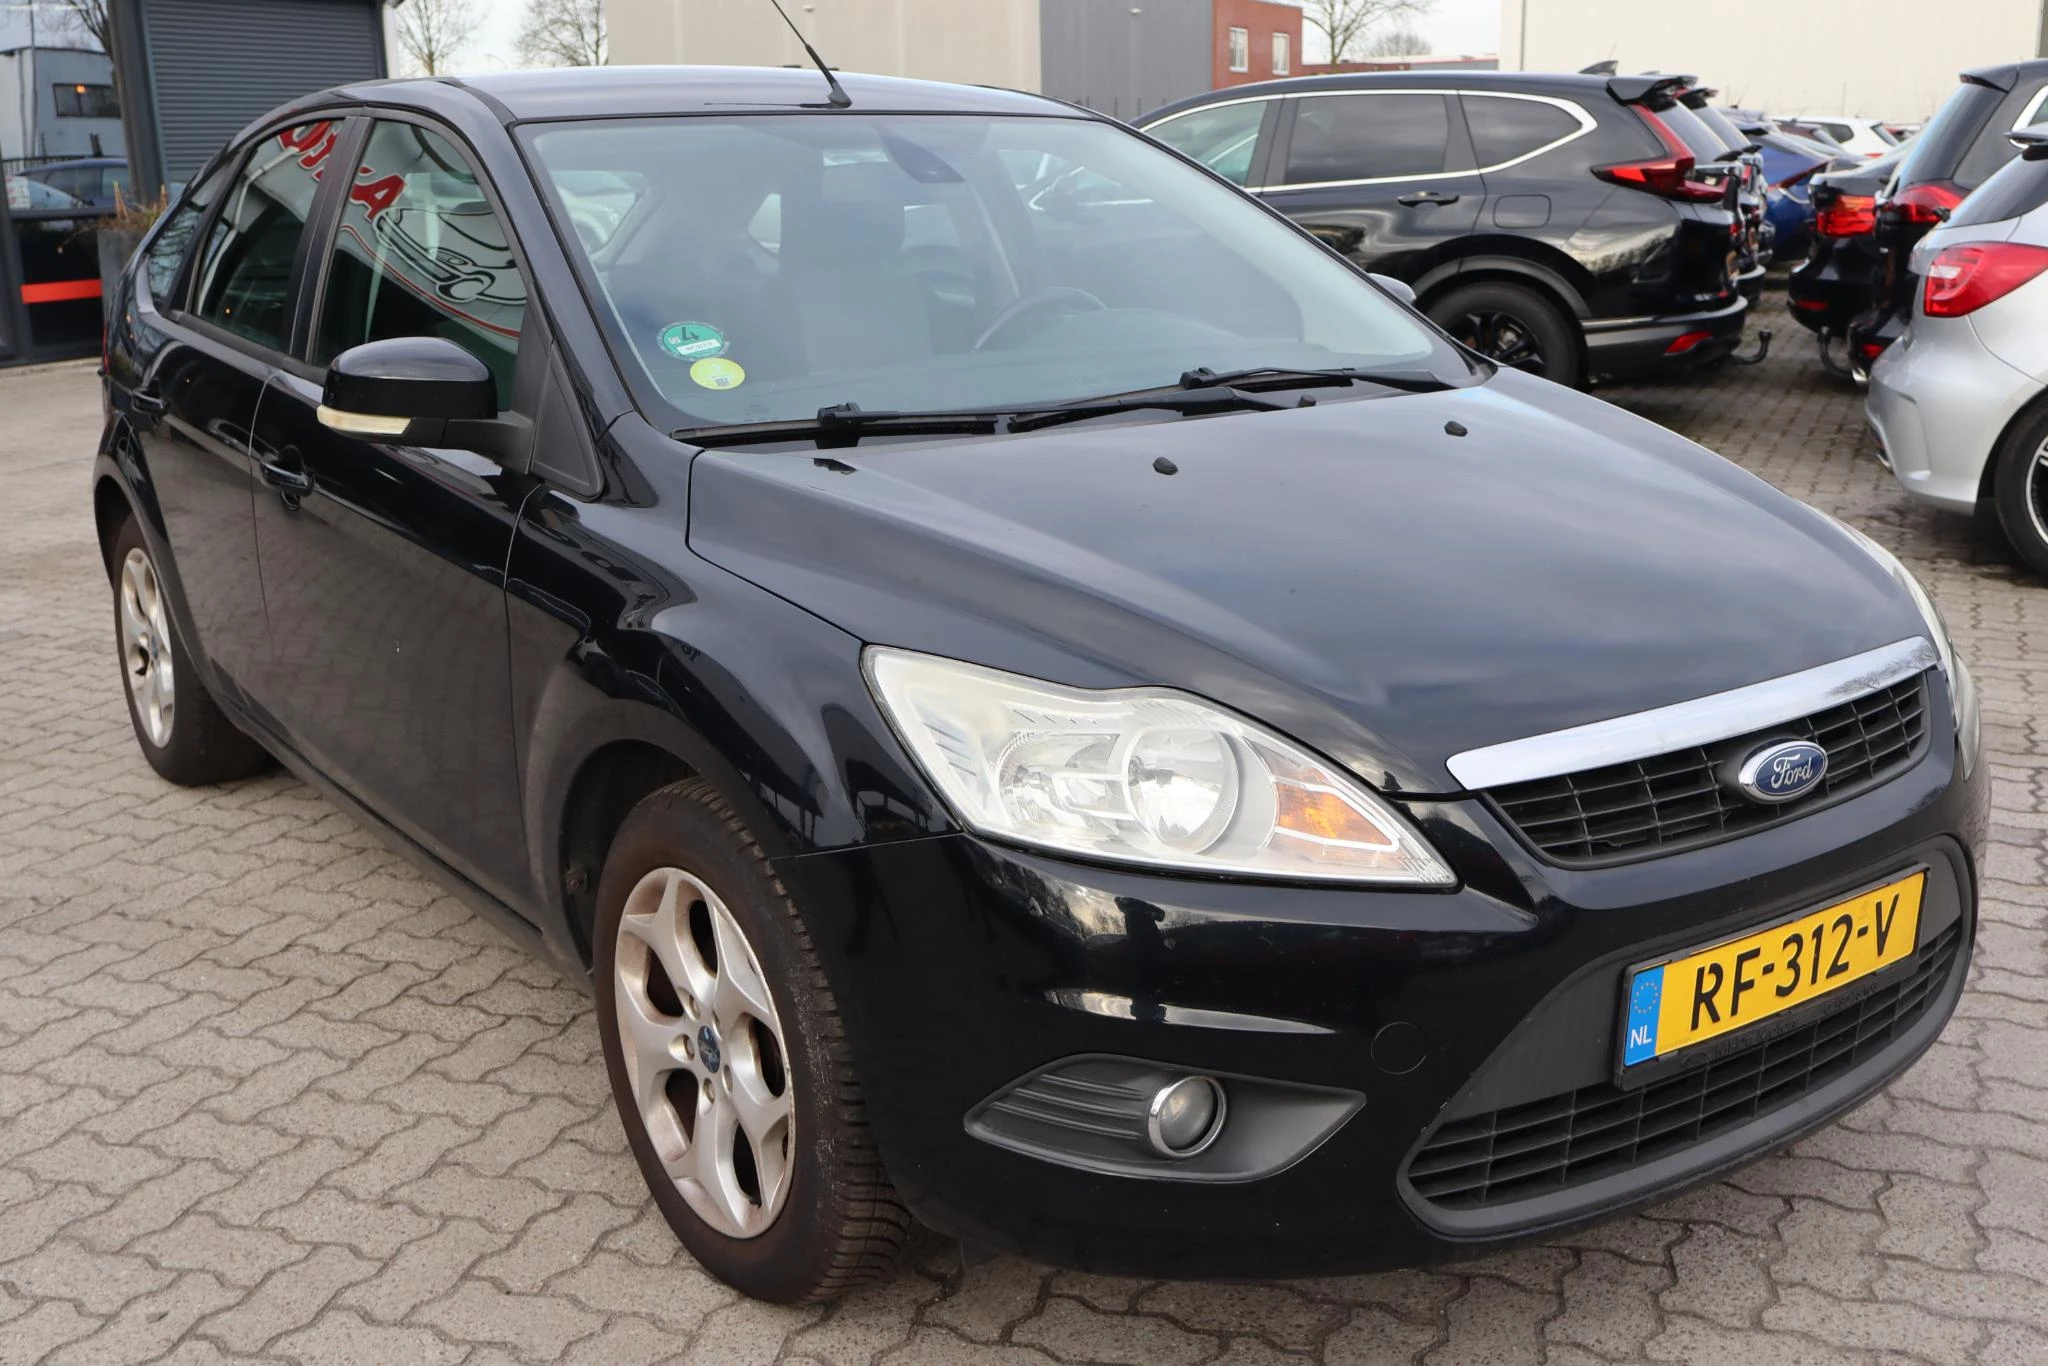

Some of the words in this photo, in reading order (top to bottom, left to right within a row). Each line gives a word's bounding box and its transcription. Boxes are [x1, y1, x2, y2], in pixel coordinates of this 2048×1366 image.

[681, 326, 699, 341] 4
[1771, 753, 1814, 789] Ford
[1690, 893, 1900, 1031] RF-312-V
[1630, 1024, 1653, 1049] NL
